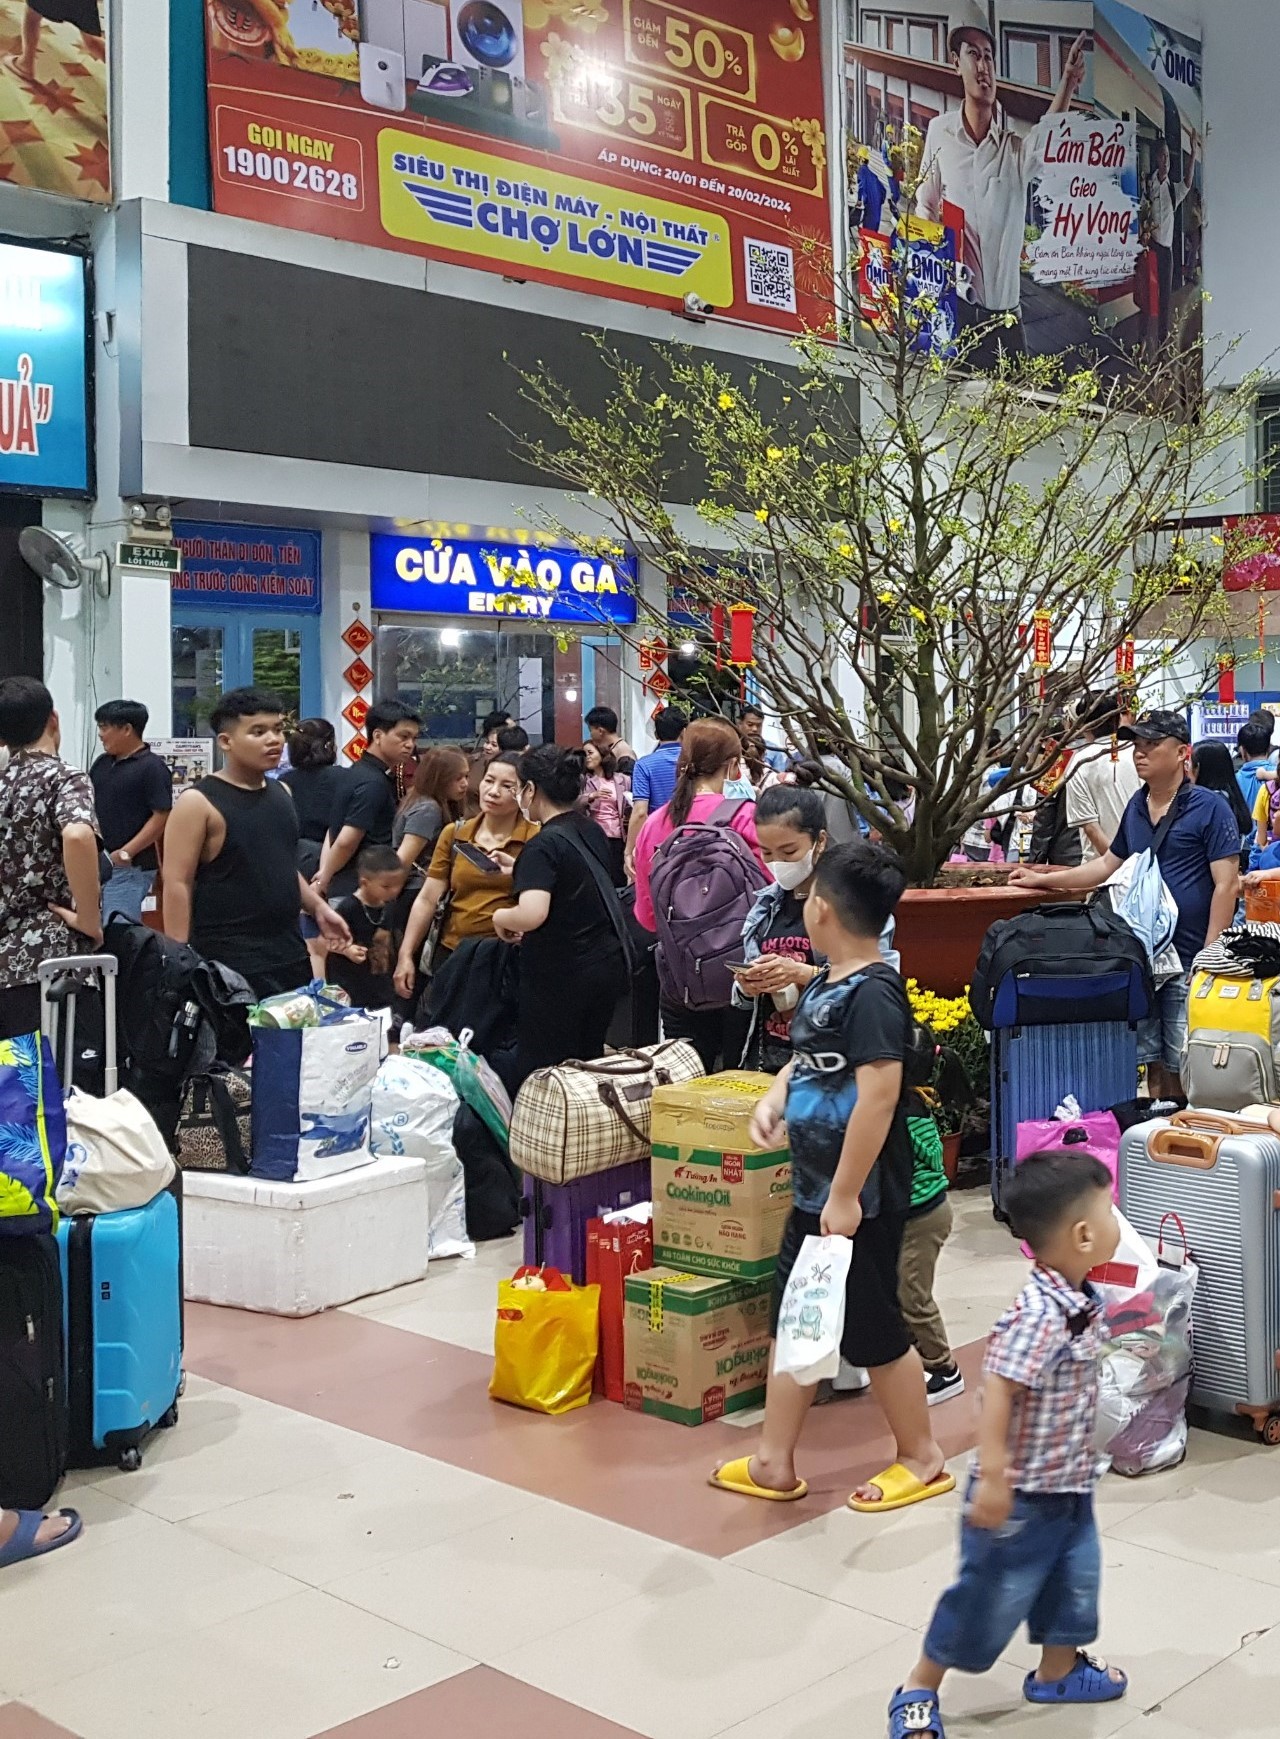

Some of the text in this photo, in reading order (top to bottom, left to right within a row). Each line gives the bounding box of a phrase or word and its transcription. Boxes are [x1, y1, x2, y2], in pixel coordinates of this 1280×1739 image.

[633, 17, 661, 34] GIẢM
[638, 32, 659, 49] ĐẾN
[665, 16, 742, 79] 50%
[1166, 49, 1195, 87] OMO
[596, 74, 656, 135] 35
[247, 123, 334, 162] GỌI NGAY
[726, 124, 745, 139] TRẢ
[726, 138, 747, 154] GÓP
[1044, 118, 1125, 168] Lấm Bẩn
[223, 145, 357, 200] 1900 2628
[598, 148, 792, 213] ÁP DỤNG: 20/01 ĐẾN 20/02/2024
[1070, 176, 1097, 198] Gieo
[392, 152, 444, 181] SIÊU
[452, 167, 489, 197] THỊ
[496, 180, 548, 209] ĐIỆN
[554, 194, 600, 219] MÁY
[620, 210, 656, 235] NỘI
[662, 219, 708, 246] THẤT
[476, 201, 645, 268] CHỢ LỚN
[1053, 201, 1131, 246] Hy Vọng
[866, 264, 889, 284] OMO
[912, 254, 942, 284] OMO
[1040, 269, 1058, 279] mang
[128, 555, 169, 568] LỐI THOÁT
[132, 546, 165, 558] EXIT
[208, 537, 236, 561] THÂN
[238, 542, 249, 562] ĐI
[278, 540, 301, 566] TIỄN
[192, 568, 227, 592] TRƯỚC
[229, 566, 257, 593] CỔNG
[259, 570, 286, 595] KIỂM
[288, 574, 314, 597] SOÁT
[395, 539, 478, 586] CỬA
[486, 550, 562, 591] VÀO
[570, 560, 618, 595] GA
[468, 591, 553, 616] ENTRY
[780, 936, 810, 950] LOTS
[673, 1251, 691, 1262] TOÀN
[691, 1257, 706, 1265] CHO
[707, 1257, 721, 1268] SỨC
